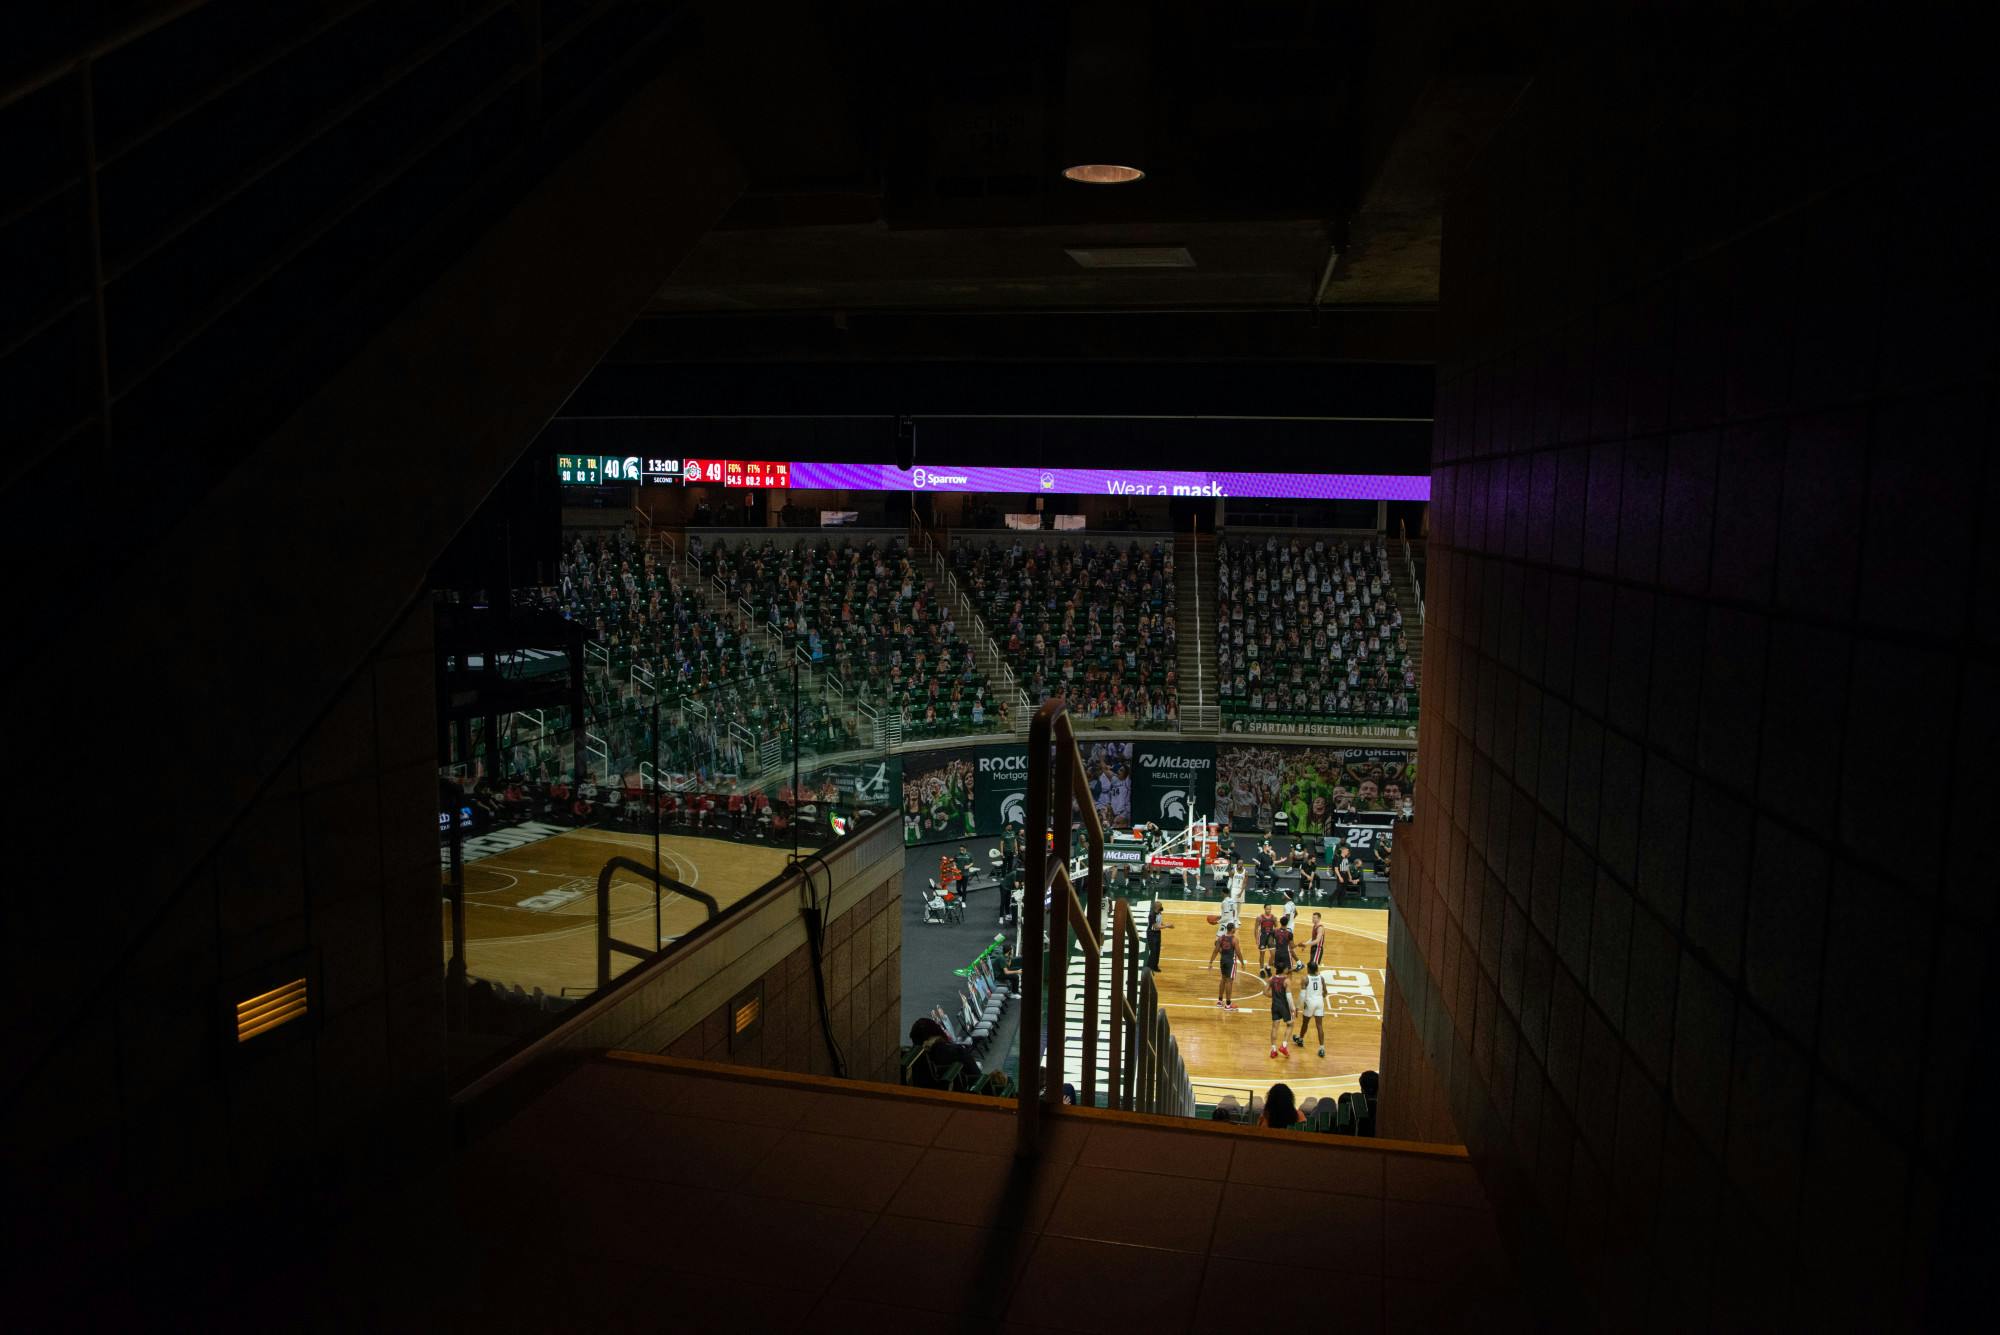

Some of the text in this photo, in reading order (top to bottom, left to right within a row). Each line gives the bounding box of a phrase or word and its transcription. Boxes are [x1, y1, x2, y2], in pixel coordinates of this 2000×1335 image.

[578, 458, 582, 468] F
[604, 460, 620, 478] 40
[648, 459, 678, 472] 13:00
[766, 464, 771, 474] F
[590, 471, 595, 481] 2
[706, 463, 721, 480] 49
[727, 475, 741, 485] 54.5
[766, 476, 774, 486] 04
[780, 476, 785, 486] 3
[928, 474, 968, 486] Sparrow
[1107, 480, 1153, 495] Wear
[1158, 485, 1167, 495] a
[1249, 722, 1399, 737] SPARTAN BASKETBALL ALUMNI
[1344, 749, 1362, 758] GO
[979, 755, 1029, 772] ROCK
[1158, 755, 1210, 768] McLaren
[993, 772, 1028, 781] Mortgag
[1346, 829, 1373, 848] 22
[1106, 851, 1140, 860] McLaren
[1313, 982, 1318, 990] 0
